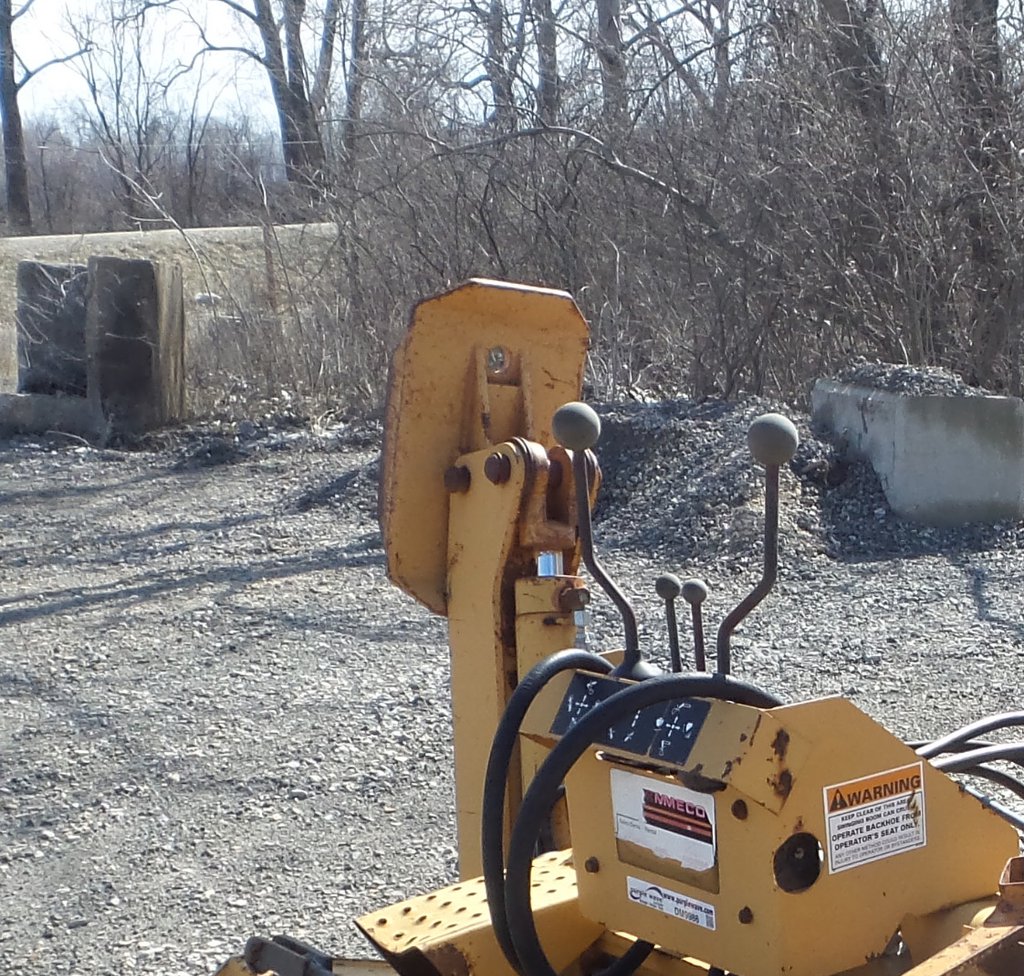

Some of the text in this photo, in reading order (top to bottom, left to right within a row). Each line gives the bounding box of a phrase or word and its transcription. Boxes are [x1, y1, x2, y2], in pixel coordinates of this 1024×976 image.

[846, 775, 921, 807] WARNING
[841, 813, 855, 822] KEEP
[856, 808, 874, 818] CLEAR
[874, 805, 882, 813] OF
[896, 798, 911, 807] ARE
[865, 813, 882, 823] BOOM
[883, 809, 895, 818] CAN
[831, 826, 864, 842] OPERATE
[865, 817, 900, 832] BACKHOE
[834, 830, 879, 851] OPERATOR'S
[880, 825, 898, 838] SEAT
